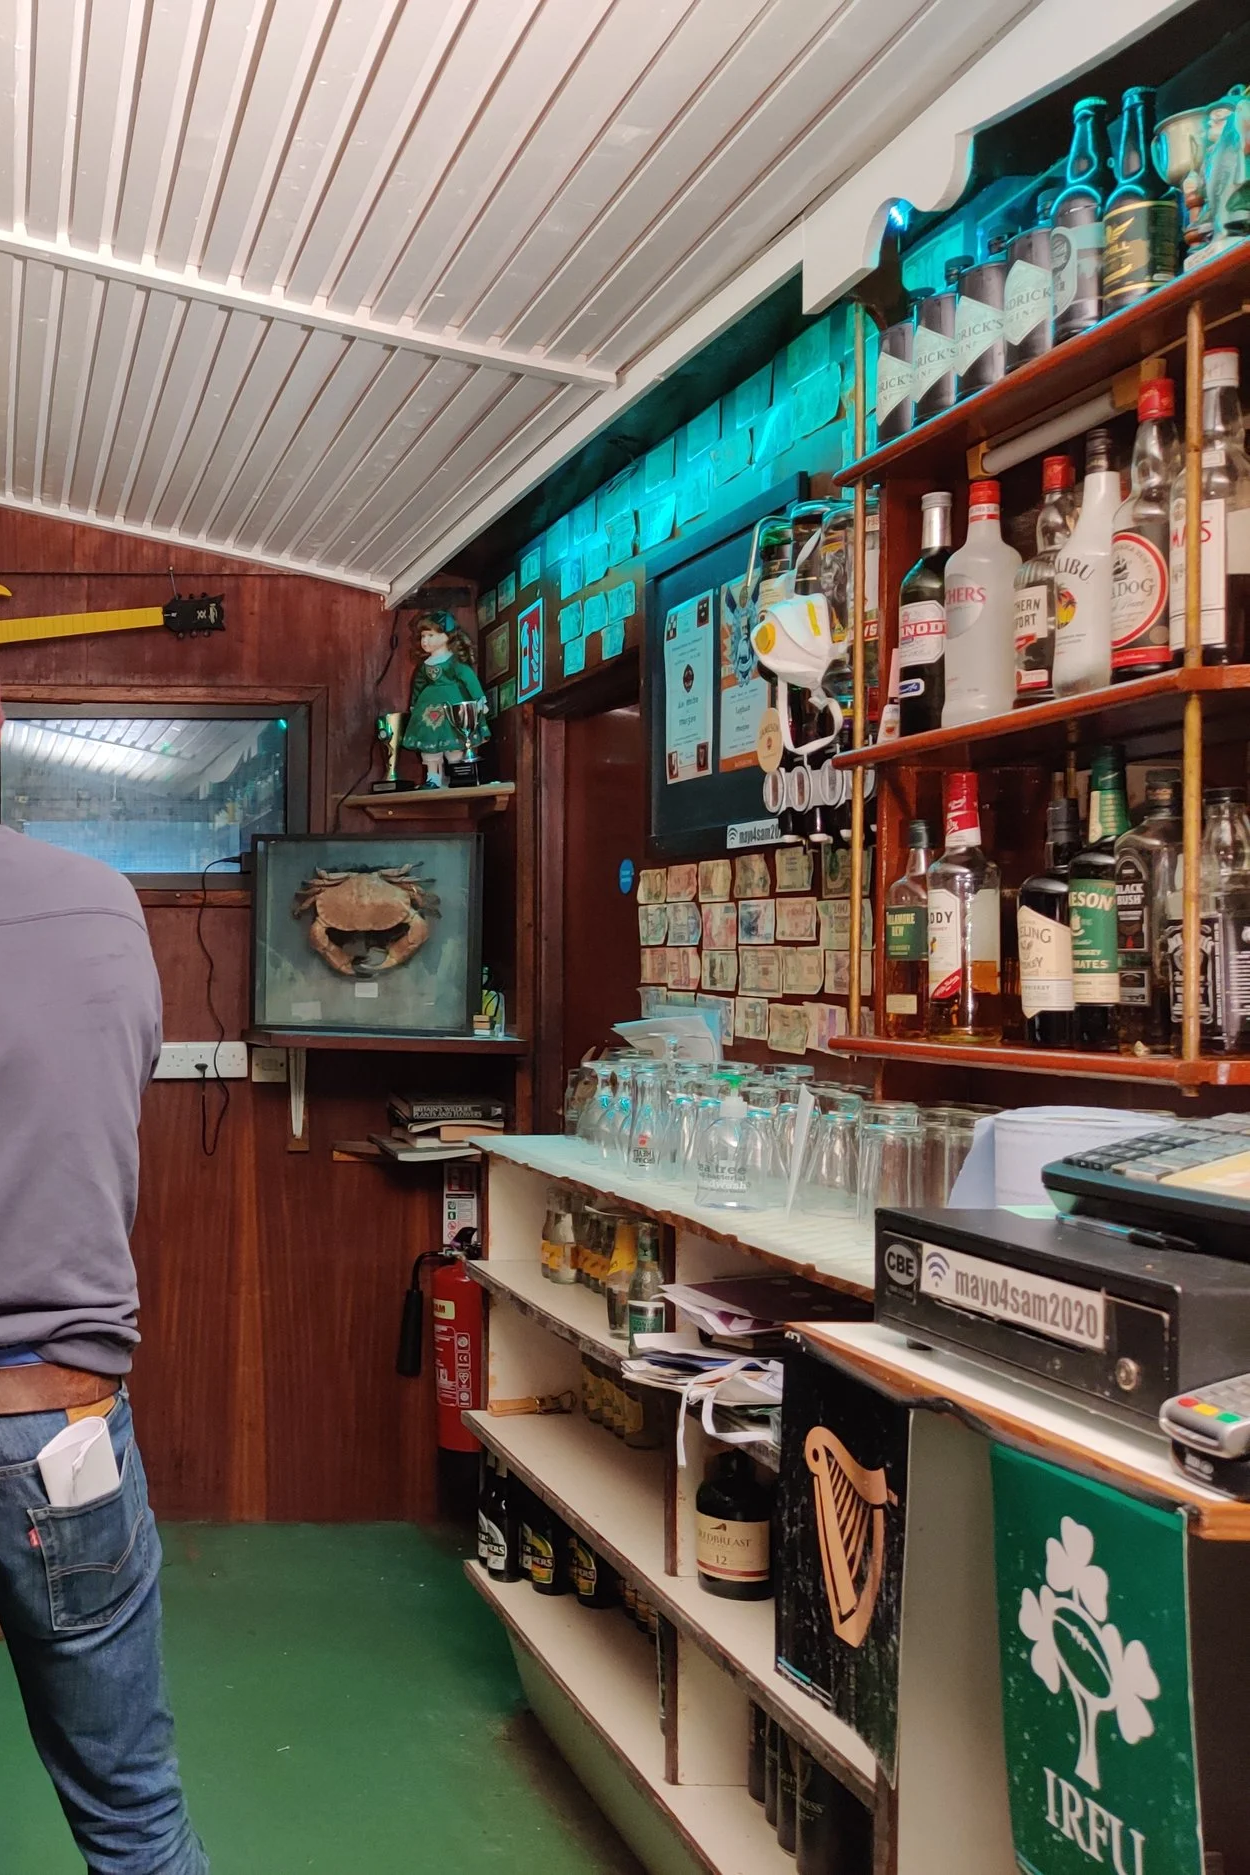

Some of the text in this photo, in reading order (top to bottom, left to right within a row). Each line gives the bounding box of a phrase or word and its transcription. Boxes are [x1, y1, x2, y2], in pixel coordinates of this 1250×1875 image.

[916, 346, 958, 369] RICK'S
[1055, 557, 1096, 582] LIBU
[1115, 883, 1145, 894] BLACK
[1116, 895, 1144, 906] BUSH
[715, 1162, 747, 1175] tree
[887, 1253, 915, 1278] CBE
[954, 1268, 1099, 1341] mayo4sam2020
[715, 1554, 728, 1566] 12
[1043, 1766, 1146, 1875] IRFU
